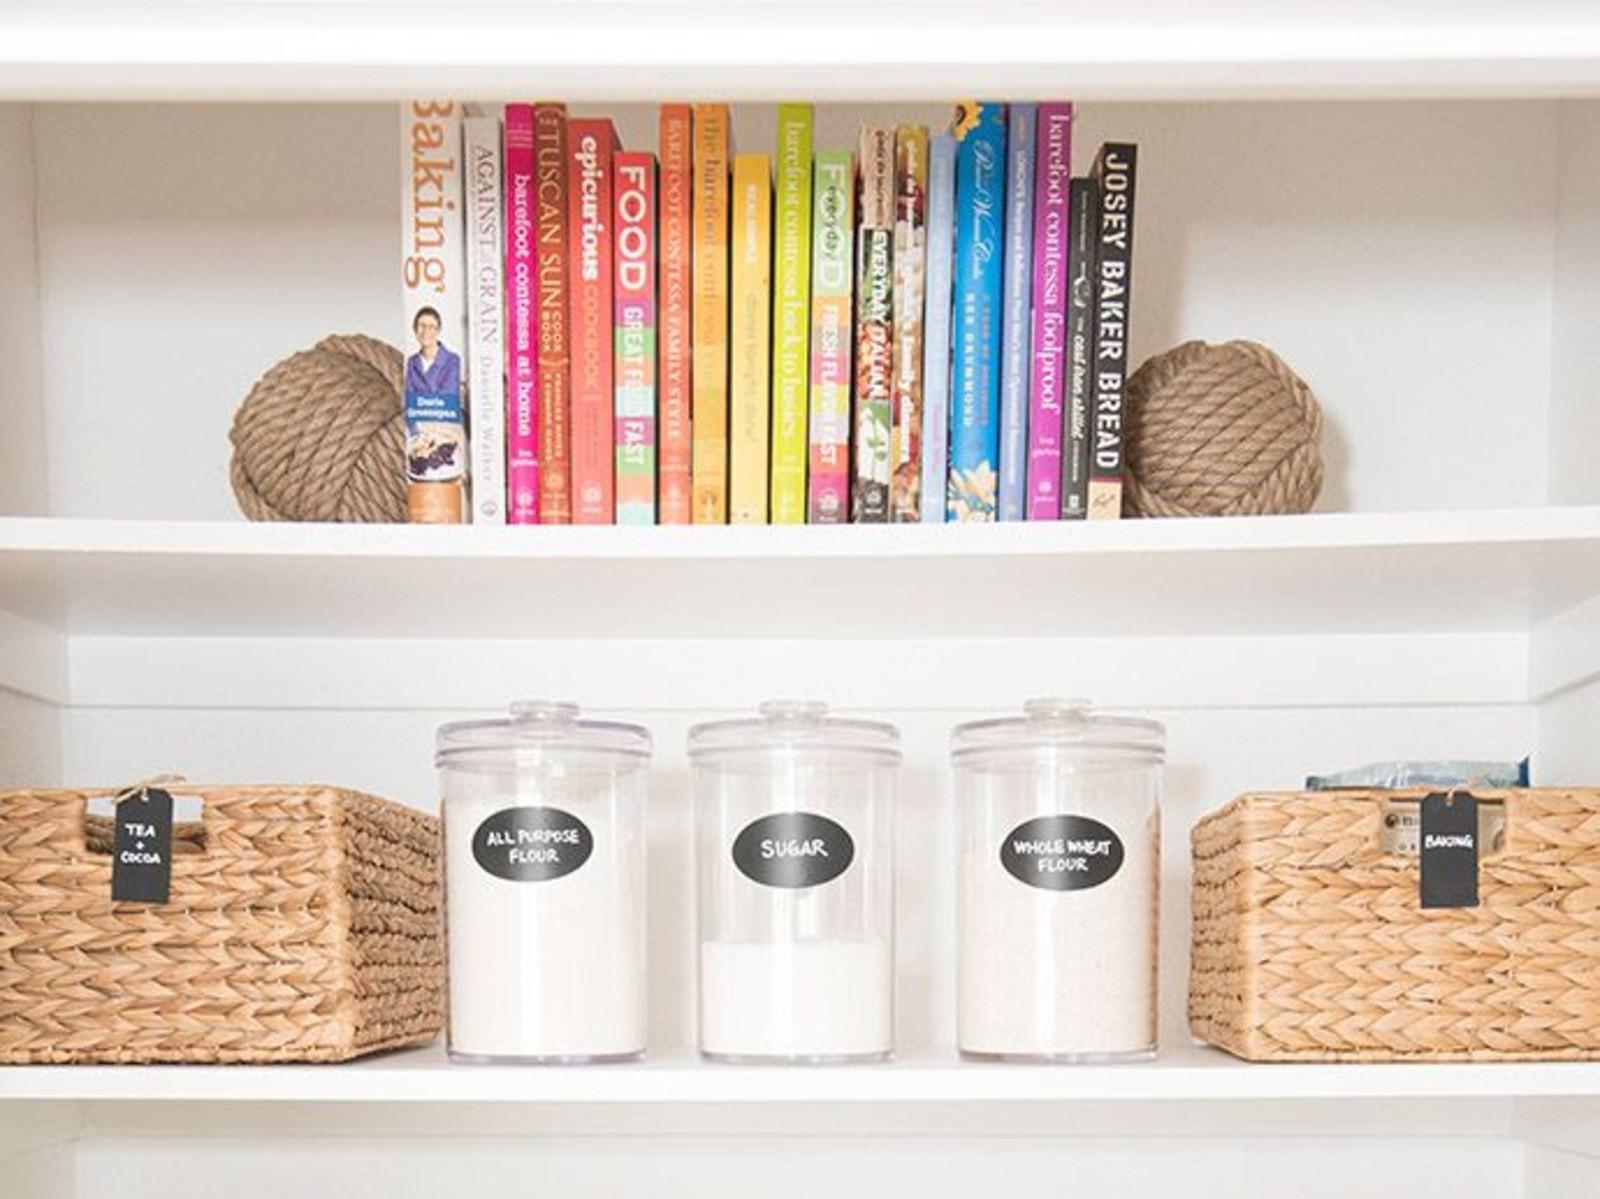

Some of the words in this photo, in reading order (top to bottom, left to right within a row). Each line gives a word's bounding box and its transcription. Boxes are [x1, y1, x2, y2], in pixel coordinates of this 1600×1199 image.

[476, 147, 496, 252] AGAINST
[538, 128, 562, 244] TUSCAN
[1048, 115, 1070, 204] barefoot
[1103, 153, 1128, 249] JOSEY
[515, 174, 531, 258] barefoot
[575, 136, 603, 280] epicurious
[619, 166, 647, 290] FOOD
[541, 253, 562, 308] SUN
[667, 218, 681, 314] CONTESSA
[870, 231, 889, 324] EVERYDAY
[1043, 212, 1063, 305] contessa
[479, 265, 498, 343] GRAIN
[516, 263, 530, 351] contessa
[1100, 260, 1126, 359] BAKER
[517, 356, 531, 377] at
[667, 317, 681, 381] FAMILY
[1036, 312, 1064, 415] foolproof
[517, 381, 533, 436] home
[624, 420, 643, 464] FAST
[1096, 373, 1122, 468] BREAD
[120, 851, 161, 864] COCOA
[124, 823, 156, 838] TEA
[486, 830, 516, 846] ALL
[518, 829, 579, 844] PURPOSE
[509, 848, 560, 864] FLOUR
[760, 838, 829, 859] SUGAR
[1012, 839, 1065, 855] WHOLE
[1067, 839, 1112, 856] WHEAT
[1038, 857, 1088, 872] FLOUR
